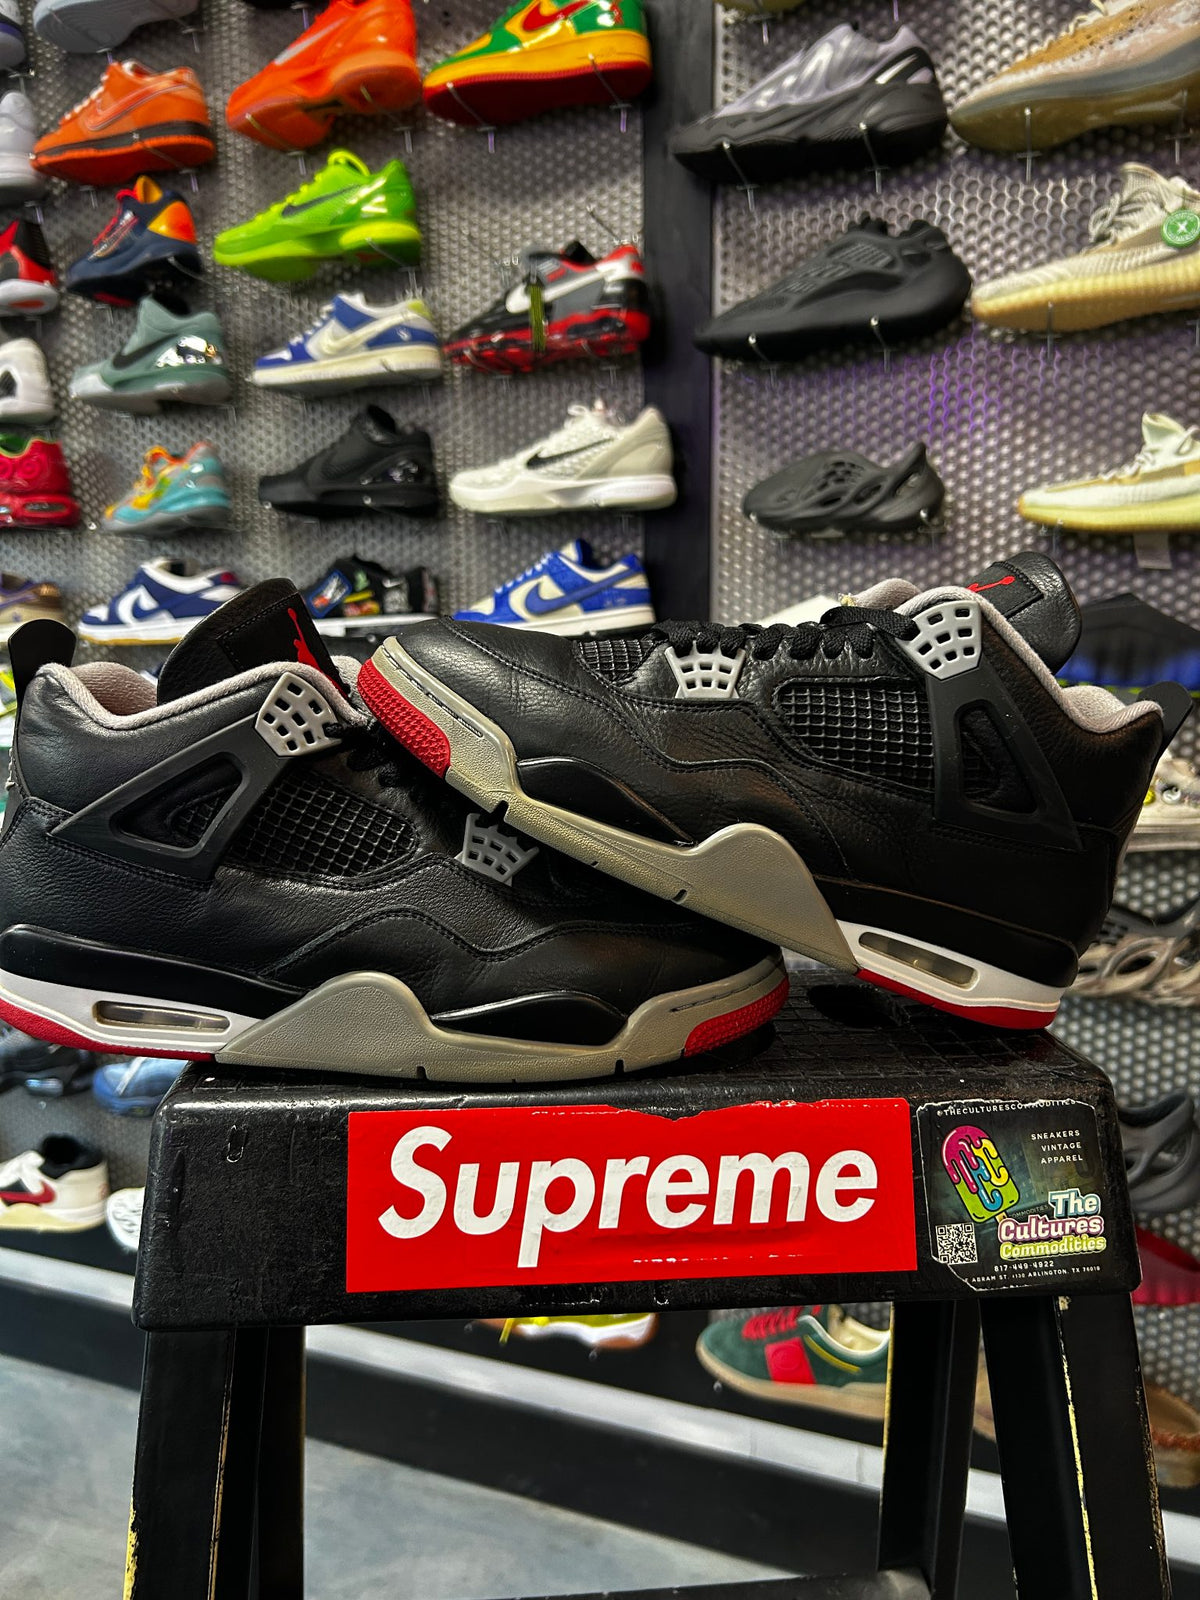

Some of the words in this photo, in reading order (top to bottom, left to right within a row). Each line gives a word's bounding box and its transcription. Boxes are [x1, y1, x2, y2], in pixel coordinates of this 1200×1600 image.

[1031, 1129, 1081, 1141] SNEAKERS
[1041, 1141, 1082, 1152] VINTAGE
[1040, 1154, 1083, 1165] APPAREL
[378, 1125, 879, 1268] Supreme
[1050, 1189, 1100, 1217] The
[999, 1216, 1103, 1242] Cultures
[1001, 1235, 1105, 1258] Commodities
[994, 1260, 1055, 1272] 817-449-4922
[972, 1275, 997, 1283] ABRAM
